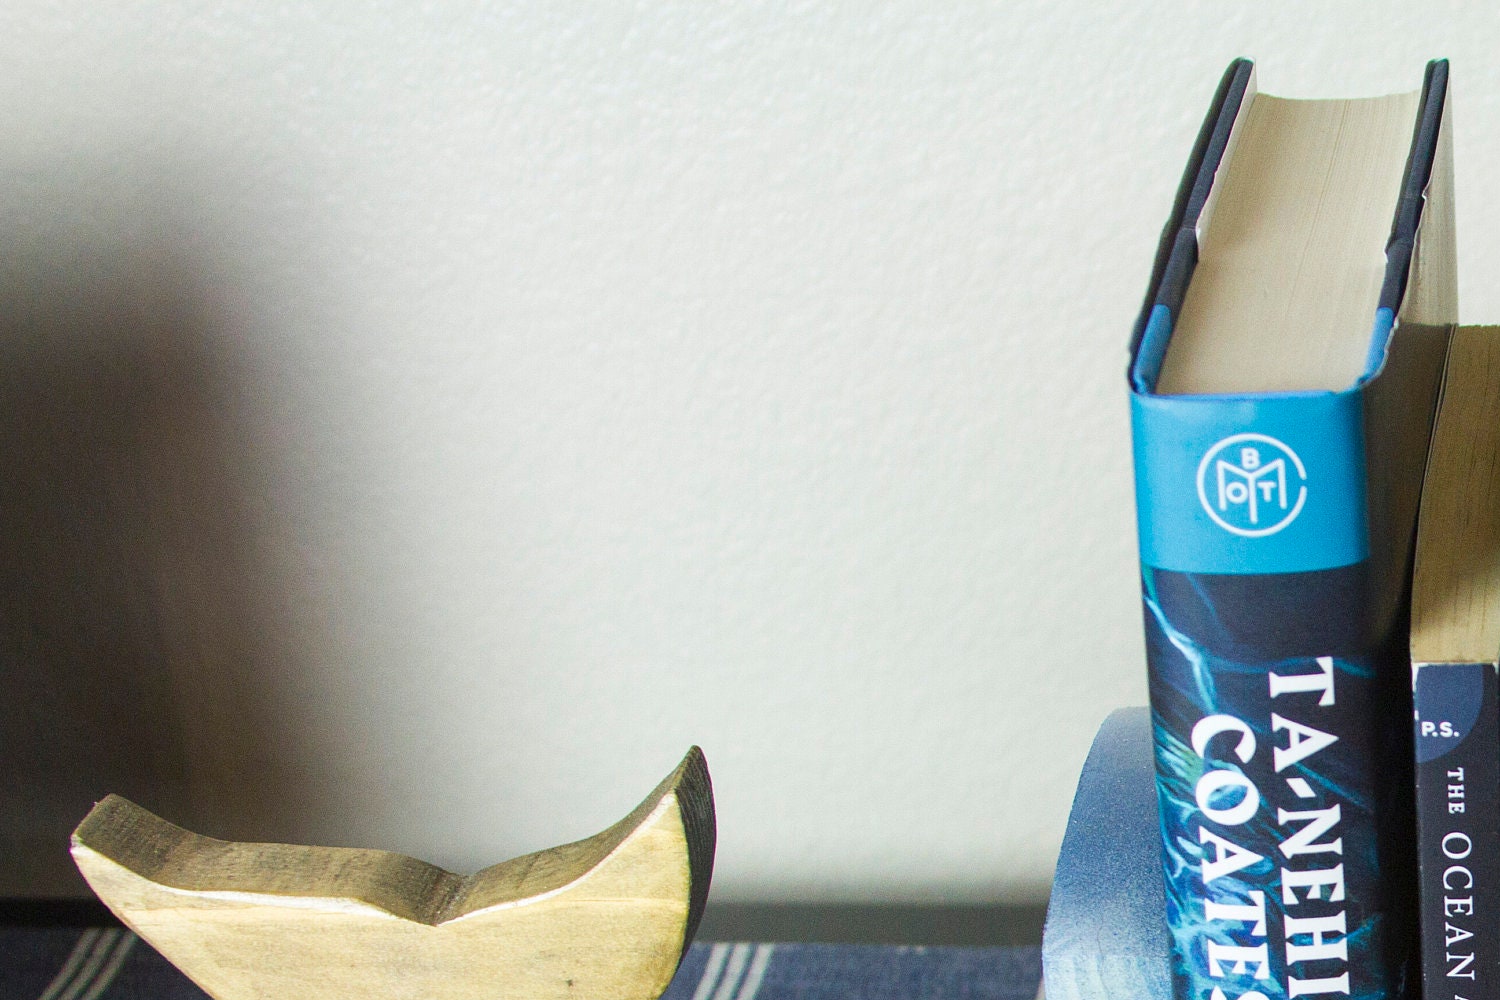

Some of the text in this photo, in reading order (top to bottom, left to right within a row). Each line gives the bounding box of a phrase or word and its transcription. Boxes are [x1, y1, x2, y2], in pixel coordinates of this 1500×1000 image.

[1420, 720, 1460, 738] P.S.
[1446, 766, 1466, 815] THE
[1441, 831, 1476, 981] OCEAN
